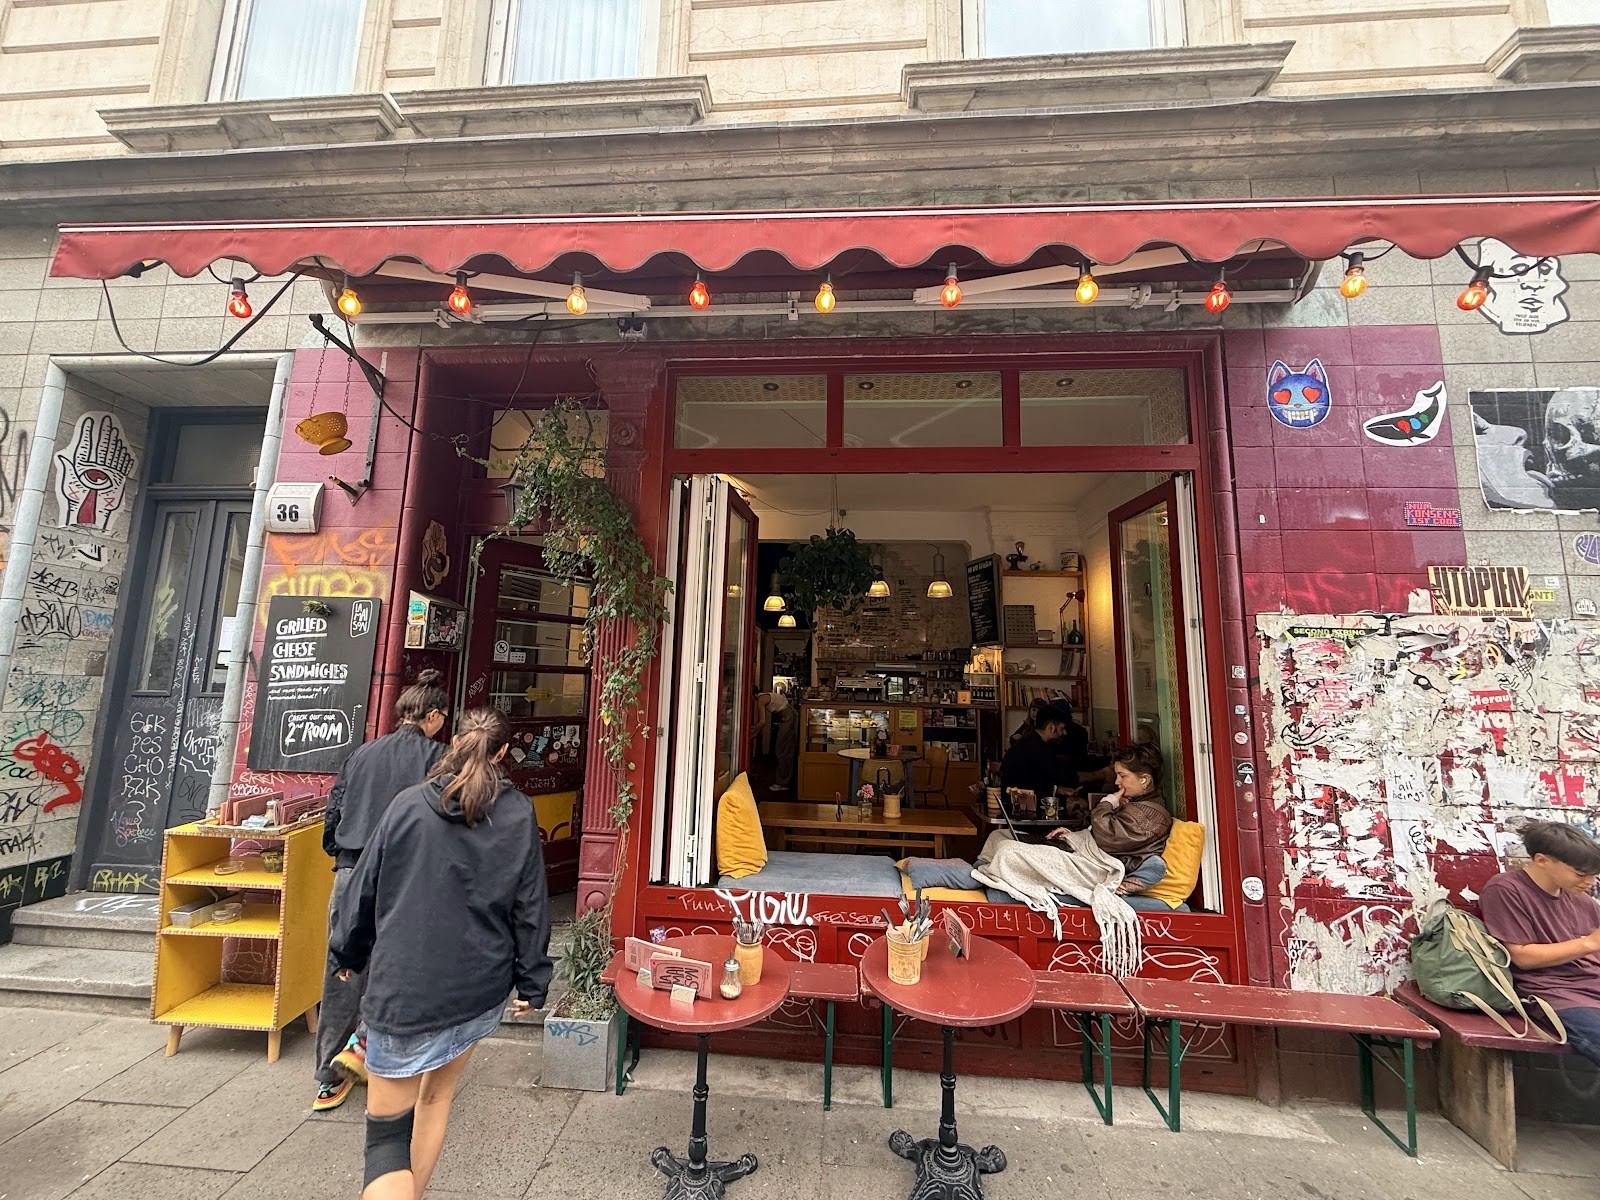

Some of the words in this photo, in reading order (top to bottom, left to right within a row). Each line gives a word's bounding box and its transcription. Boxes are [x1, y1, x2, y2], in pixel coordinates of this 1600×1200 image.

[277, 503, 299, 522] 36
[1407, 510, 1459, 518] KONSENS
[1433, 566, 1527, 608] UTOPIEN
[354, 607, 369, 622] MAI
[355, 603, 363, 613] LA
[1293, 627, 1330, 635] SECOND
[272, 642, 317, 658] CHEESE
[288, 714, 308, 722] CHECK
[302, 722, 342, 744] ROOM
[1399, 780, 1414, 791] all
[1392, 789, 1426, 802] beings
[658, 974, 672, 984] LA
[666, 966, 684, 986] MAI
